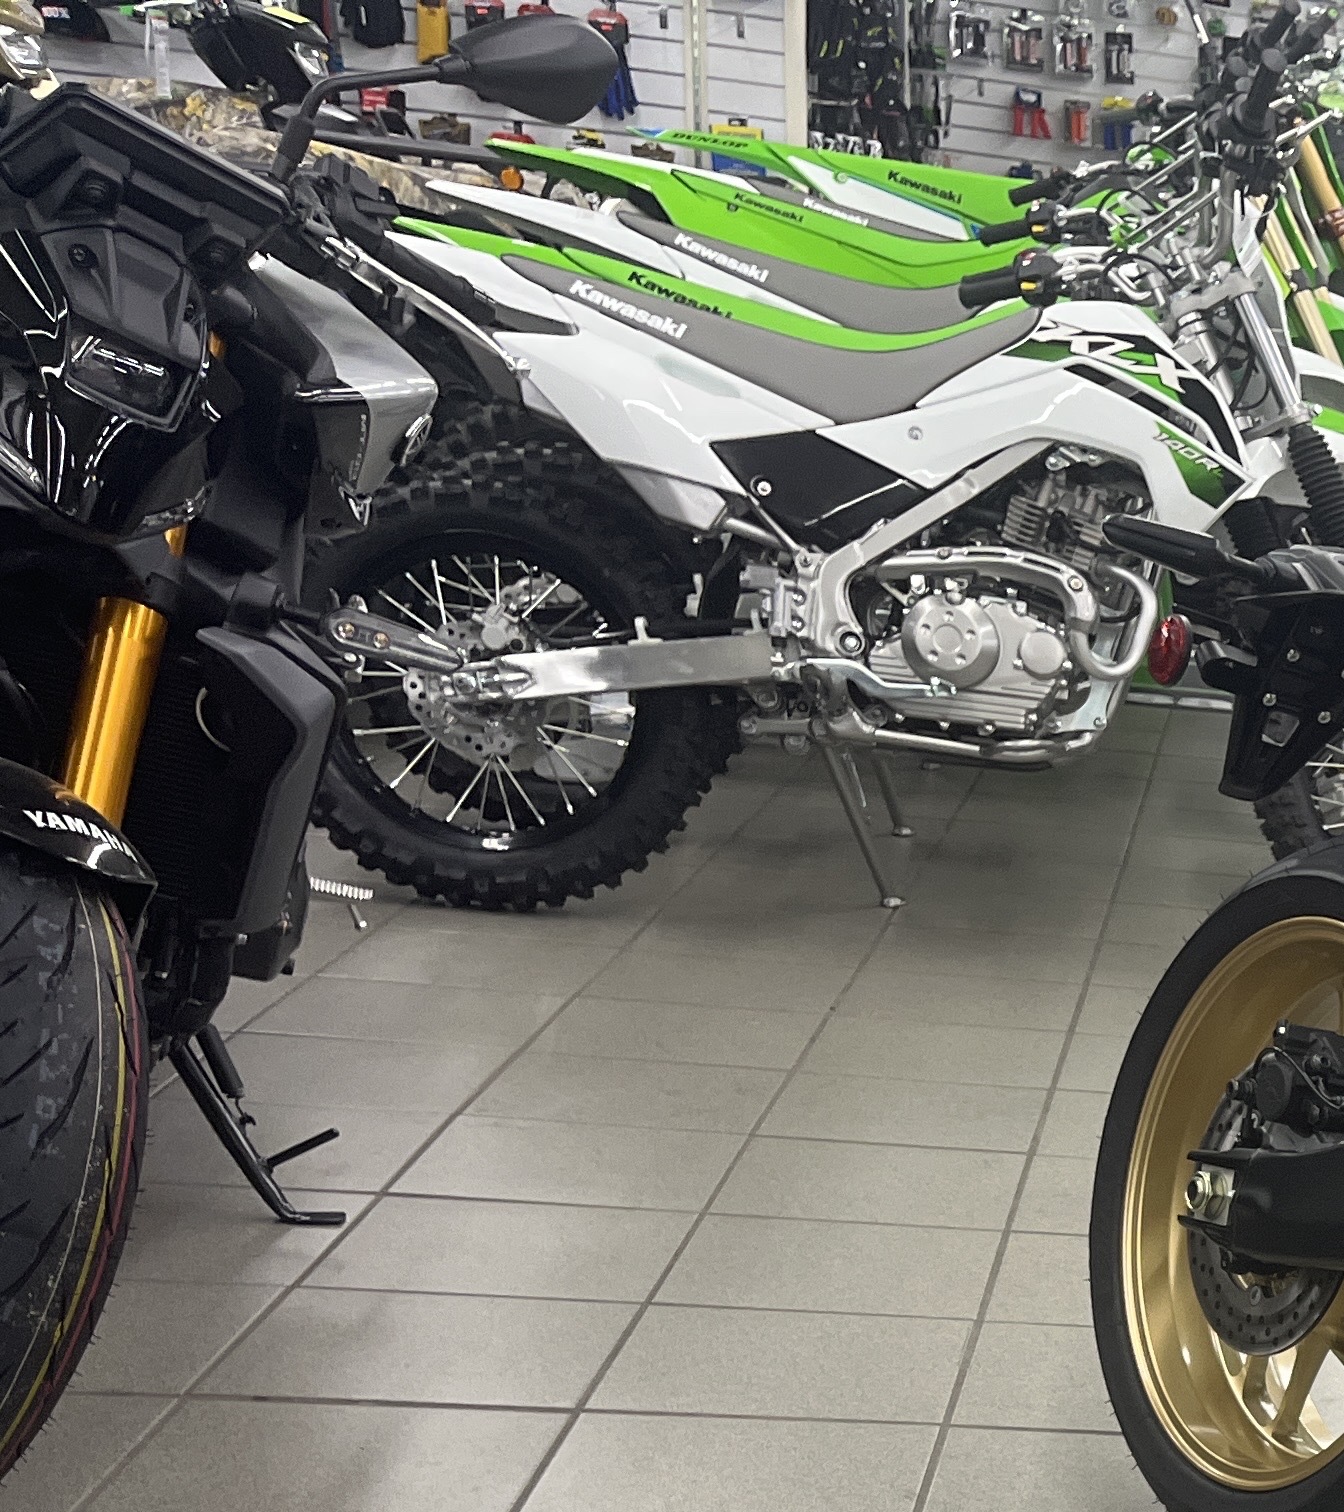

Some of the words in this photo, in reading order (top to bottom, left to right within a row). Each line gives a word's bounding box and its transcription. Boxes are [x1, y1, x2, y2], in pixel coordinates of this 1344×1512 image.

[671, 132, 749, 150] DUNLOP
[733, 192, 804, 223] Kawasaki
[887, 169, 963, 204] Kawasaki
[673, 232, 770, 284] Kawasaki
[568, 279, 688, 341] Kawasaki
[626, 270, 735, 320] Kawasaki
